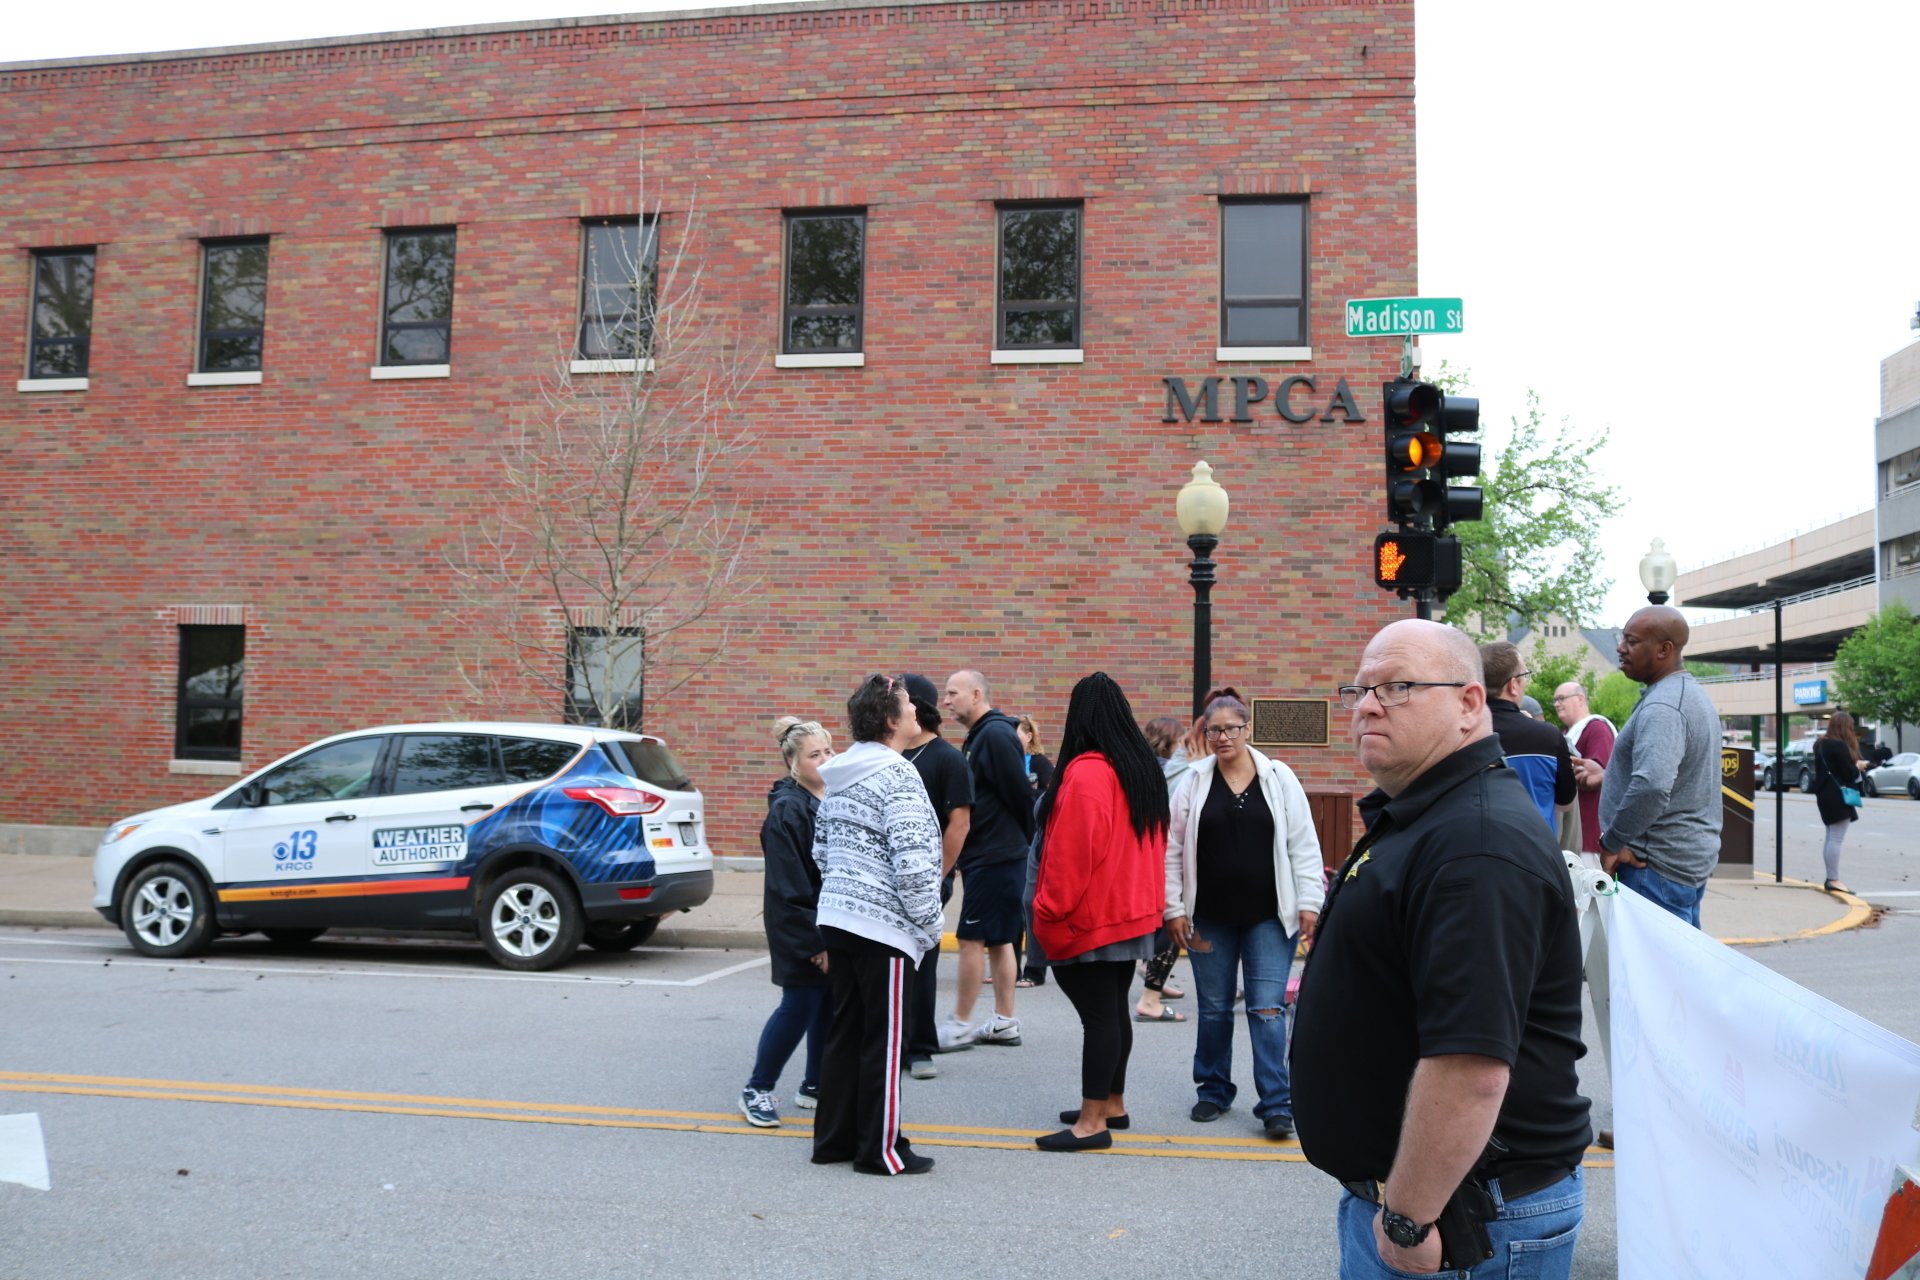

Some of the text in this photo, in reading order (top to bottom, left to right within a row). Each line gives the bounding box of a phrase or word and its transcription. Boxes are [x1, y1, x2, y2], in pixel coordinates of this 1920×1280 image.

[1349, 304, 1463, 333] Madison St
[1162, 375, 1366, 423] MPCA
[1794, 686, 1821, 699] PARKING
[289, 830, 318, 860] 13
[376, 827, 463, 847] WEATHER
[379, 844, 463, 862] AUTHORITY
[275, 862, 314, 872] KRCG
